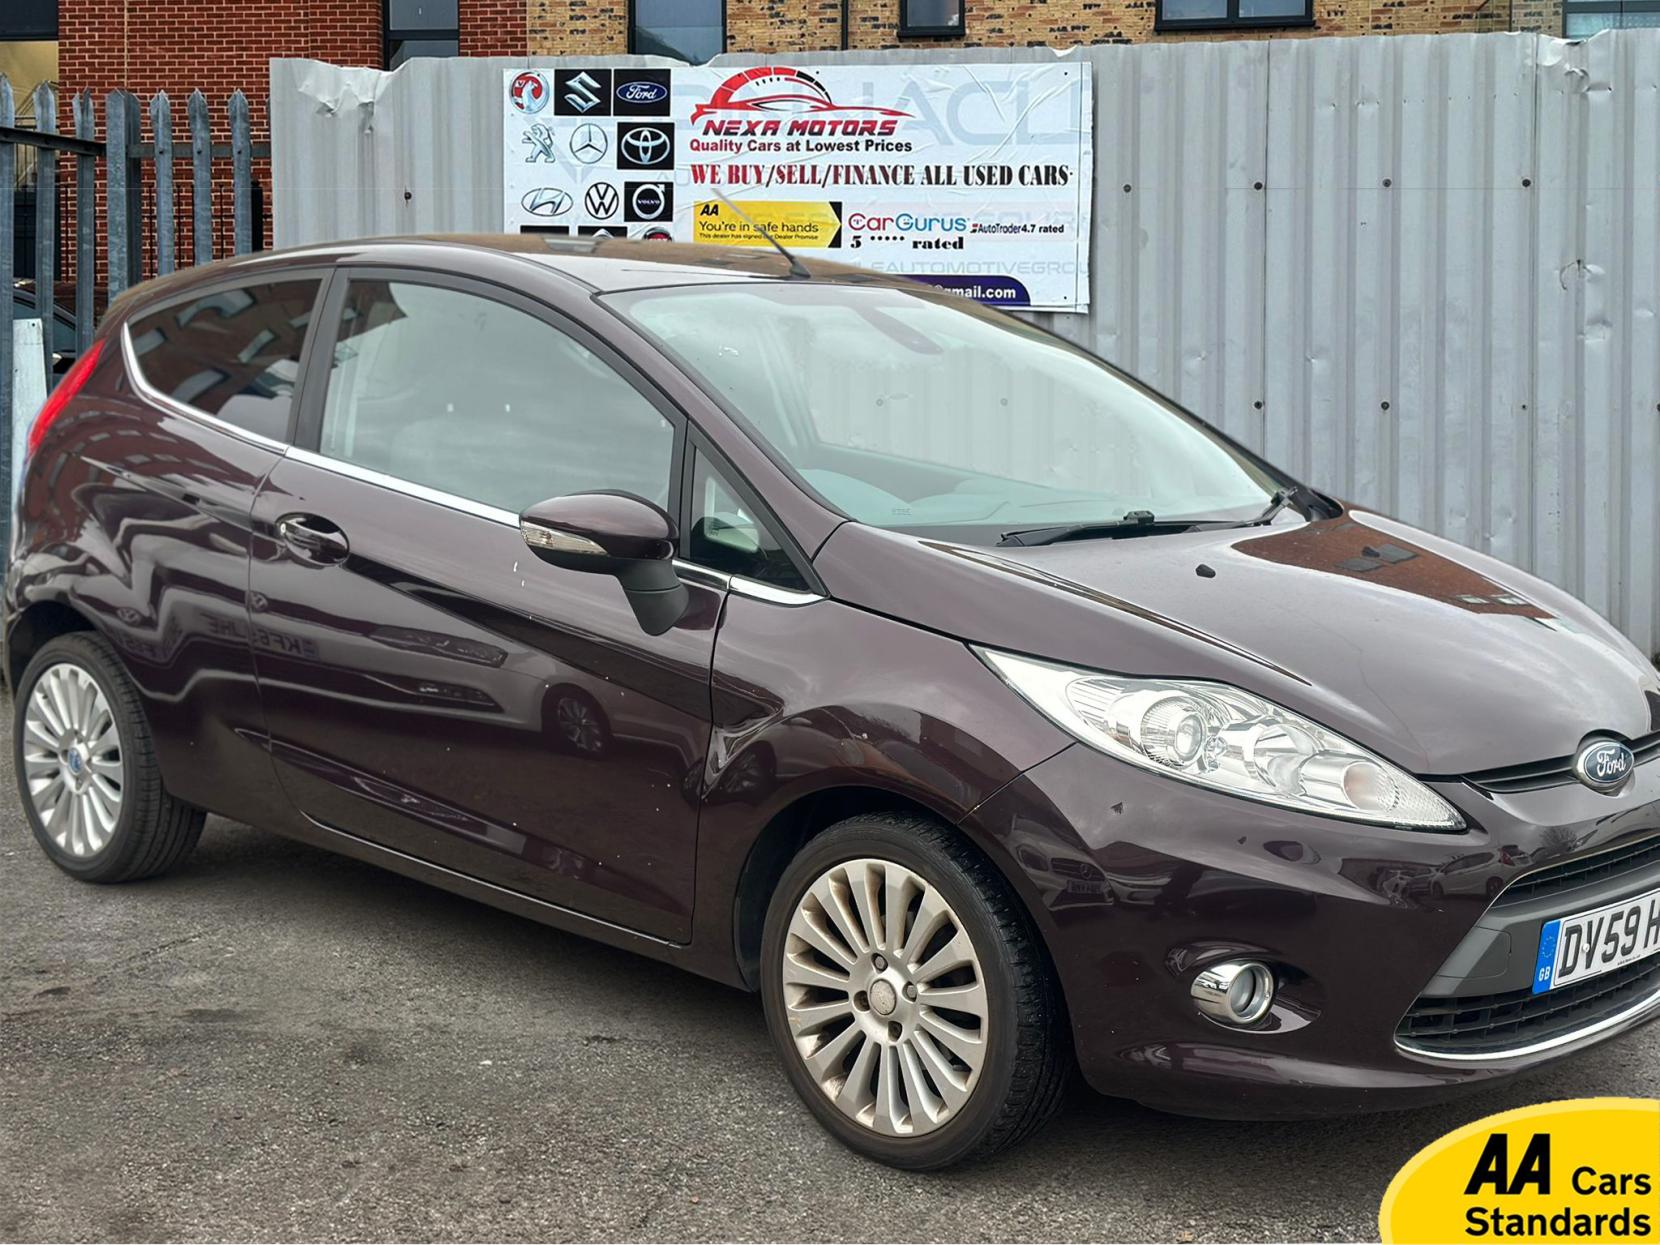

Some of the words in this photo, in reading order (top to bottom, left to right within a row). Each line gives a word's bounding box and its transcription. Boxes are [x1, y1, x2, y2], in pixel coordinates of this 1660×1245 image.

[626, 85, 657, 99] Ford
[702, 120, 781, 136] NEXA
[787, 120, 898, 136] MOTORS
[690, 139, 743, 154] Quality
[750, 140, 781, 152] Cars
[786, 141, 800, 152] at
[806, 140, 860, 152] Lowest
[865, 139, 912, 152] Prices
[690, 165, 721, 185] WE
[920, 165, 957, 185] ALL
[963, 165, 1013, 186] USED
[1018, 165, 1069, 186] CARS
[700, 204, 719, 216] AA
[699, 221, 736, 232] You're
[740, 221, 750, 232] in
[753, 221, 778, 232] safe
[781, 222, 819, 233] hands
[848, 213, 967, 232] CarGurus
[1039, 224, 1065, 233] rated
[850, 236, 862, 249] 5
[912, 237, 964, 250] rated
[1596, 748, 1627, 777] Ford
[1558, 905, 1641, 978] DV59
[1538, 966, 1551, 982] GB
